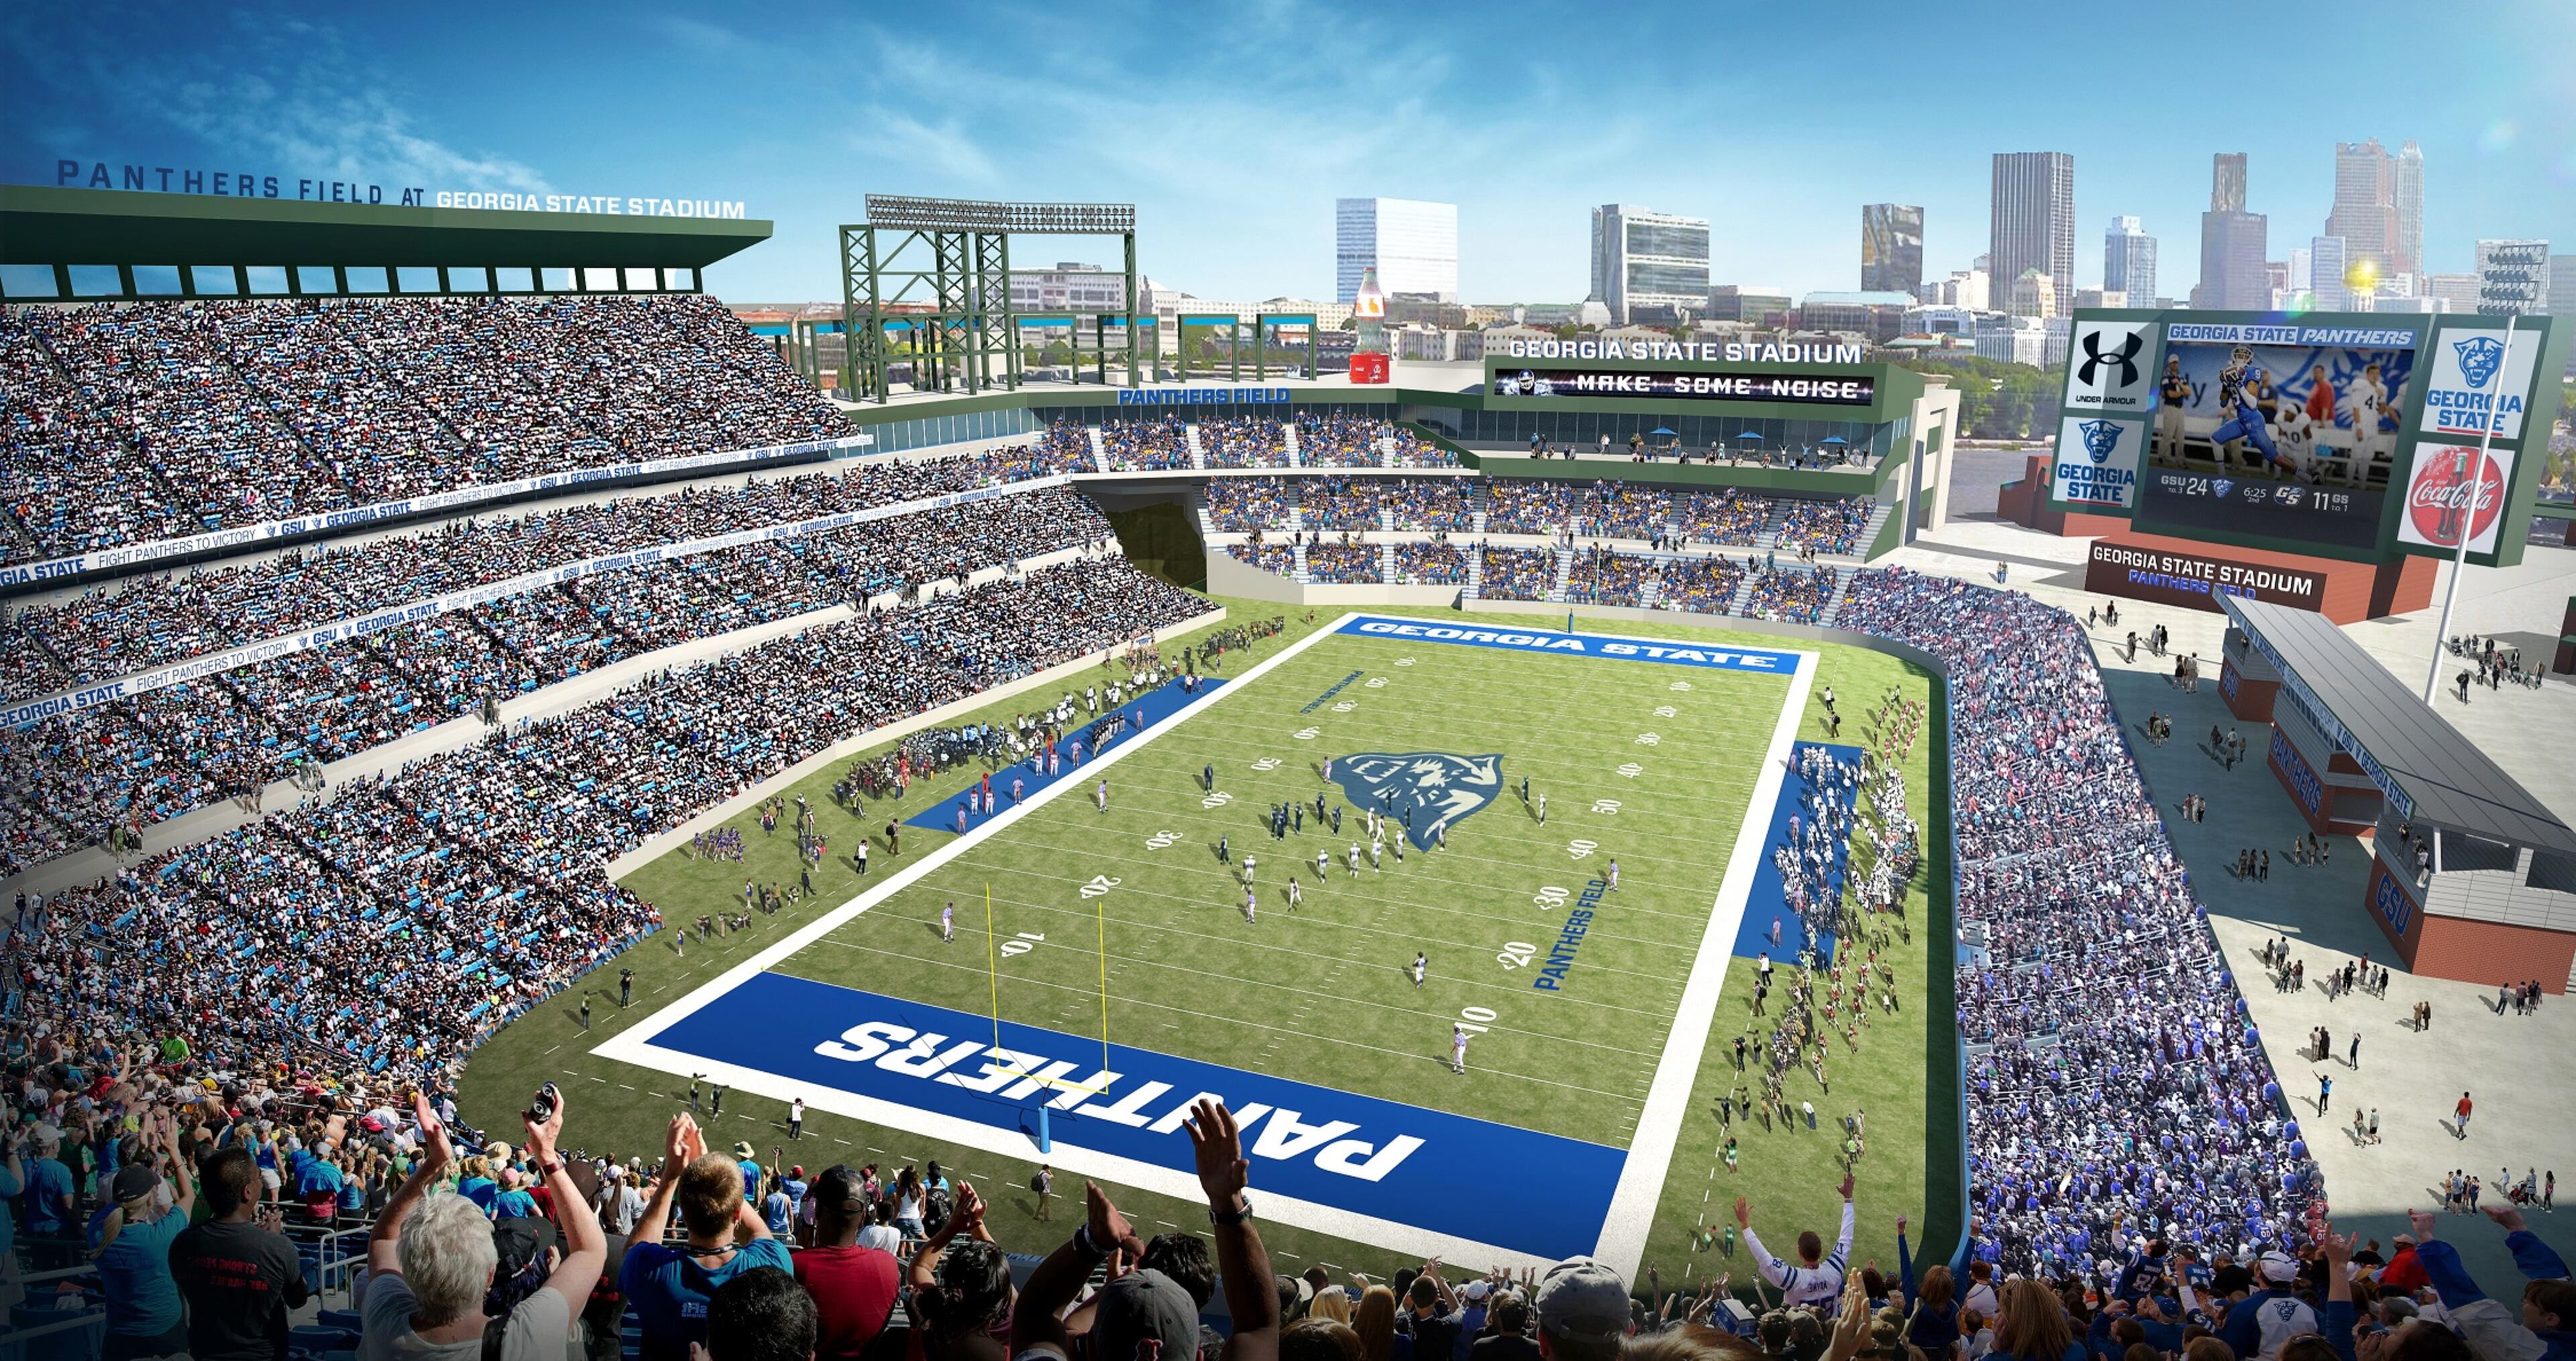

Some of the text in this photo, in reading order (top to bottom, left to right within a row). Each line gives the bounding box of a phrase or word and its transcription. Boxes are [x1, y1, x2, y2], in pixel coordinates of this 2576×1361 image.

[58, 160, 745, 219] PANTHERS FIELD AT GEORGIA STATE STADIUM
[2169, 325, 2413, 345] GEORGIA STATE PANTHERS
[1509, 340, 1863, 364] GEORGIA STATE STADIUM
[1118, 388, 1290, 404] PANTHERS FIELD
[1577, 374, 1859, 399] MAKE SOME NOISE
[2076, 395, 2136, 405] UNDER ARMOUR
[2427, 390, 2522, 413] GEORGIA
[2438, 409, 2506, 431] STATE
[2057, 464, 2135, 486] GEORGIA
[2161, 475, 2208, 496] GSU 24
[2068, 482, 2123, 502] STATE
[2243, 488, 2267, 498] 6:25
[2314, 492, 2349, 510] 11 GS
[35, 557, 85, 580] STATE
[99, 550, 132, 567] FIGHT
[136, 541, 193, 560] PANTHERS
[195, 537, 210, 549] TO
[213, 529, 256, 548] VICTORY
[281, 519, 306, 535] GSU
[327, 508, 376, 527] GEORGIA
[380, 502, 413, 518] STATE
[419, 496, 441, 510] FIGHT
[444, 489, 482, 506] PANTHERS
[483, 487, 493, 498] TO
[539, 476, 557, 488] GSU
[571, 468, 612, 483] GEORGIA
[614, 465, 643, 478] STATE
[755, 449, 771, 459] GSU
[783, 443, 815, 456] GEORGIA
[816, 441, 838, 452] STATE
[2094, 547, 2312, 596] GEORGIA STATE STADIUM
[2128, 569, 2210, 594] PANTHERS
[0, 696, 72, 728] GEORGIA
[75, 683, 125, 706] STATE
[137, 673, 170, 691] FIGHT
[172, 657, 228, 679] PANTHERS
[231, 653, 244, 665] TO
[247, 641, 288, 663] VICTORY
[313, 628, 336, 645] GSU
[357, 610, 405, 633] GEORGIA
[407, 602, 440, 622] STATE
[470, 585, 506, 604] PANTHERS
[563, 567, 580, 580] GSU
[592, 556, 633, 572] GEORGIA
[635, 549, 663, 563] STATE
[773, 527, 788, 538] GSU
[800, 519, 831, 533] GEORGIA
[833, 514, 854, 525] STATE
[1359, 622, 1778, 669] GEORGIA STATE
[1250, 757, 1283, 771] 50
[2270, 729, 2323, 818] PANTHERS
[2342, 730, 2355, 753] GSU
[2361, 753, 2387, 792] GEORGIA
[2387, 783, 2410, 816] STATE
[1201, 790, 1233, 808] 40
[1591, 798, 1621, 815] 50
[1145, 830, 1183, 851] 30
[1567, 839, 1598, 859] 40
[1079, 875, 1122, 897] 20
[1533, 886, 1570, 908] 30
[2376, 872, 2412, 937] GSU
[1001, 932, 1045, 956] 10
[1533, 879, 1607, 991] PANTHERS FIELD
[1497, 941, 1537, 968] 20
[1454, 1006, 1497, 1034] 10
[814, 1020, 1426, 1183] PANTHERS
